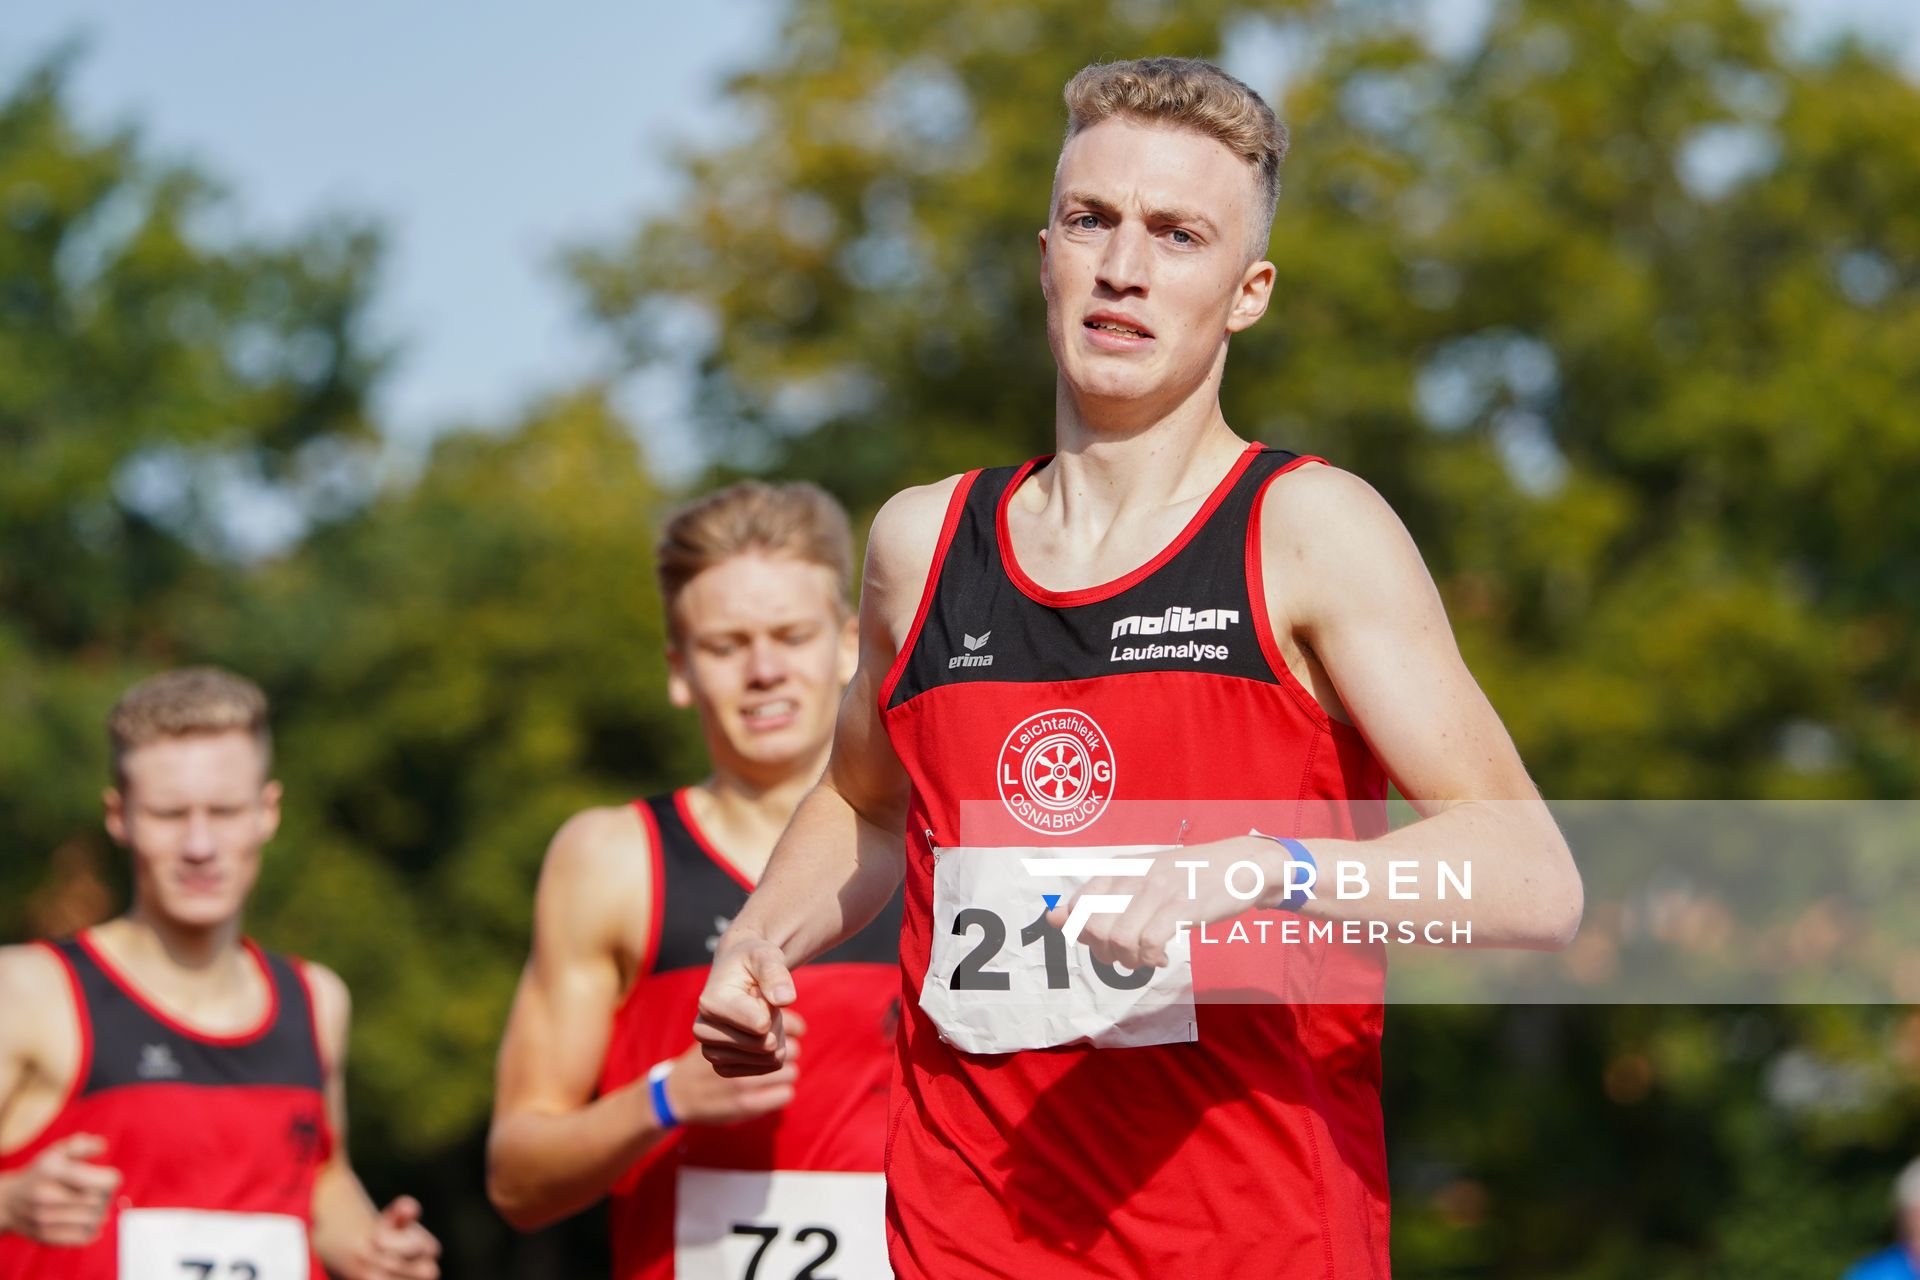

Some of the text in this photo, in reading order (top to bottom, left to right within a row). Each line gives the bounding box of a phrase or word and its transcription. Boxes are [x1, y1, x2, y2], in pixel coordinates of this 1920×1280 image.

[1110, 606, 1239, 639] molitor
[949, 653, 994, 669] erima
[1110, 641, 1229, 662] Laufanalyse
[1010, 716, 1100, 753] Leichtathletik
[1010, 790, 1103, 828] OSNABRÜCK
[731, 1224, 838, 1280] 72
